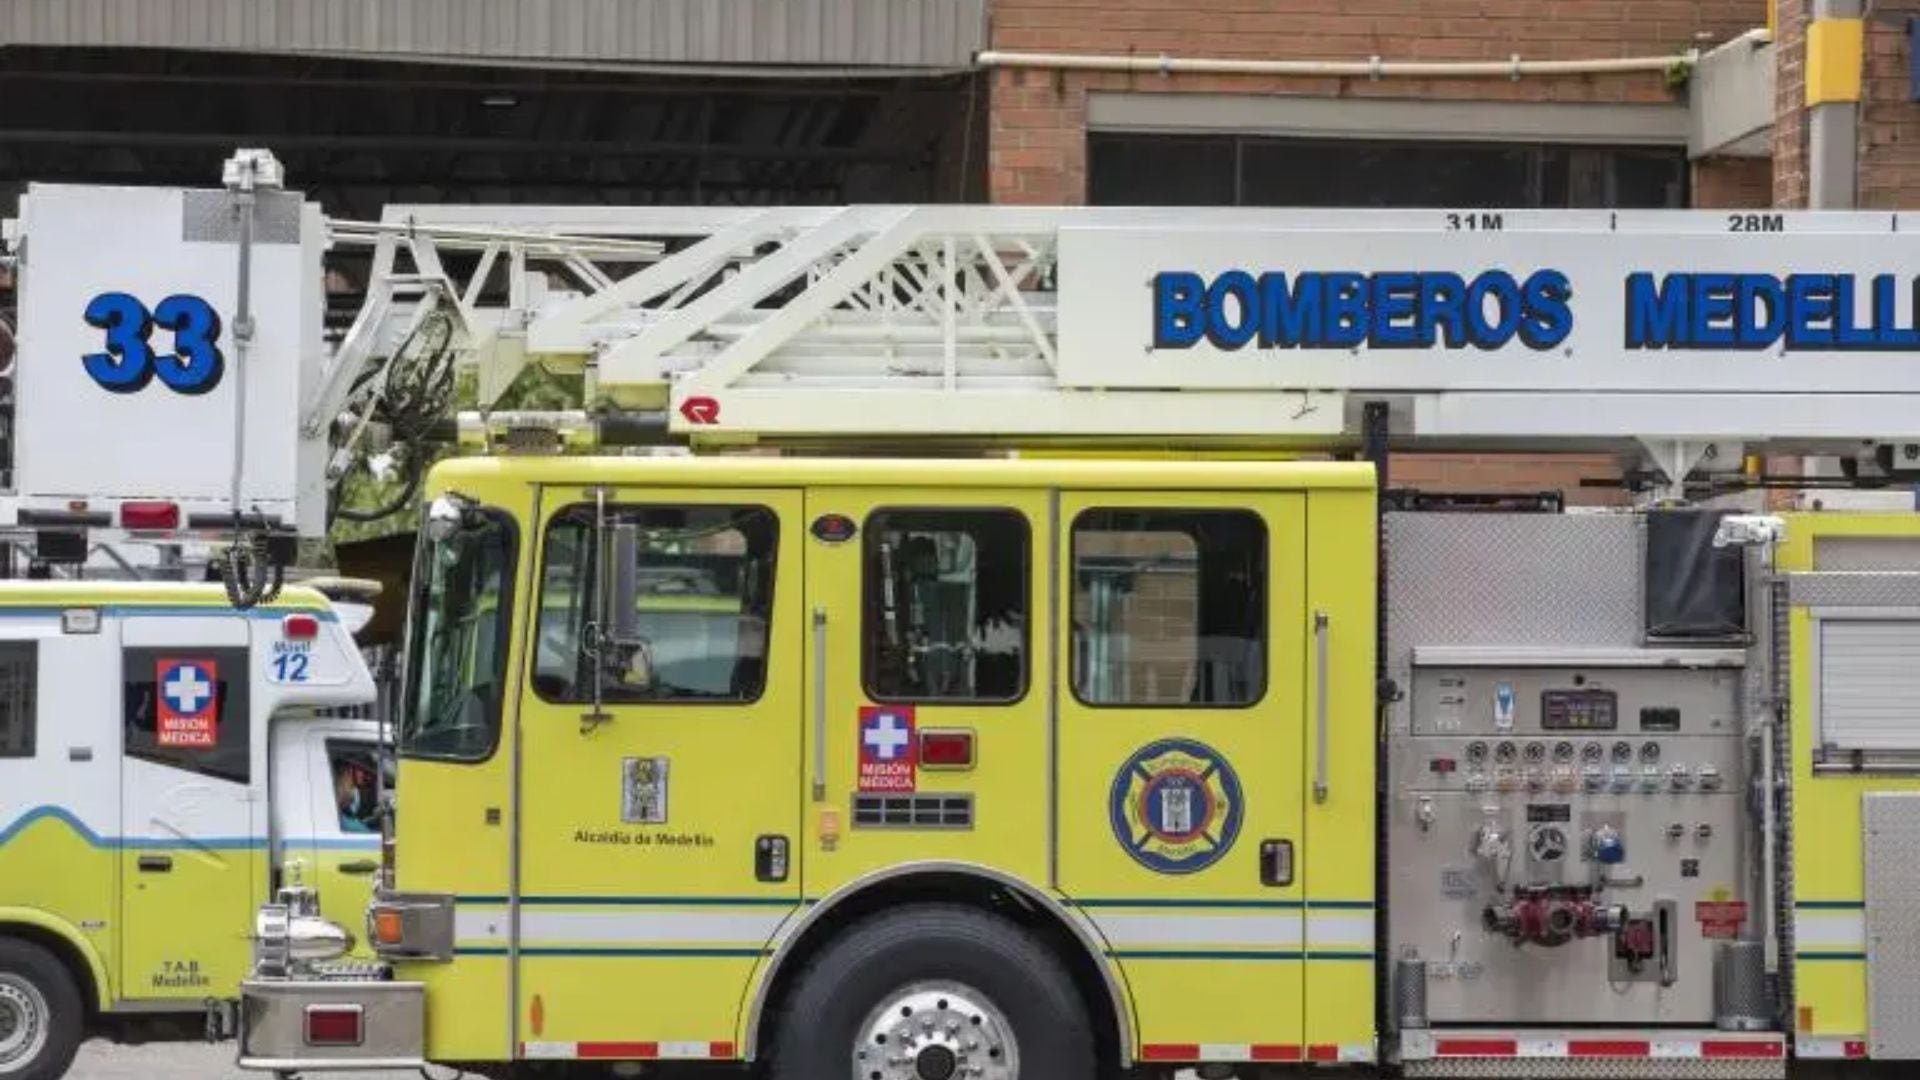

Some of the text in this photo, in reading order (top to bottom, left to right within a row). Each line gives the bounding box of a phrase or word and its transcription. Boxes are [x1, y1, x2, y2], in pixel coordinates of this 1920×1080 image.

[1446, 213, 1503, 231] 31M
[1728, 214, 1784, 232] 28M
[1153, 269, 1920, 351] BOMBEROS MEDELL
[81, 291, 225, 394] 33
[273, 654, 310, 681] 12
